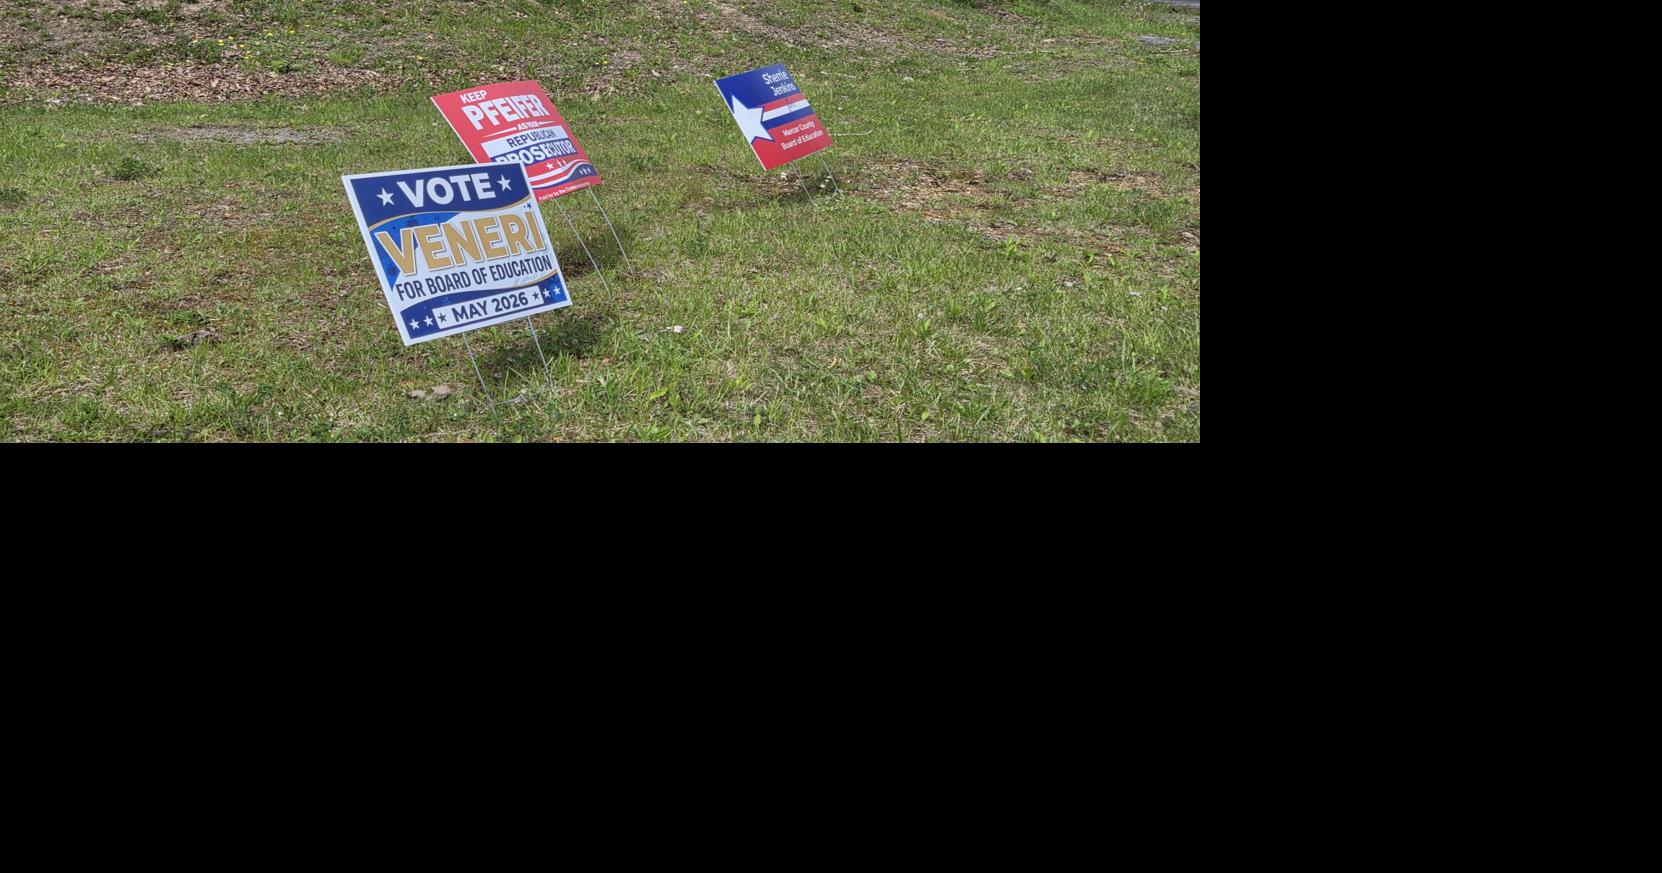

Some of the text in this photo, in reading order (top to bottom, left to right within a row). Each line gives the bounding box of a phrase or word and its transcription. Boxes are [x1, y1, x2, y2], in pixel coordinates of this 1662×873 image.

[460, 90, 487, 104] KEEP
[770, 82, 797, 96] Jenkins
[461, 94, 550, 130] PFEIFER
[517, 122, 528, 130] AS
[782, 120, 815, 136] Mercer County
[507, 129, 557, 148] REPUBLICAN
[781, 130, 824, 150] Board of Education
[397, 172, 496, 208] VOTE
[374, 211, 547, 276] VENERI
[396, 254, 552, 301] FOR BOARD OF EDUCATION
[452, 291, 528, 322] MAY 2026
